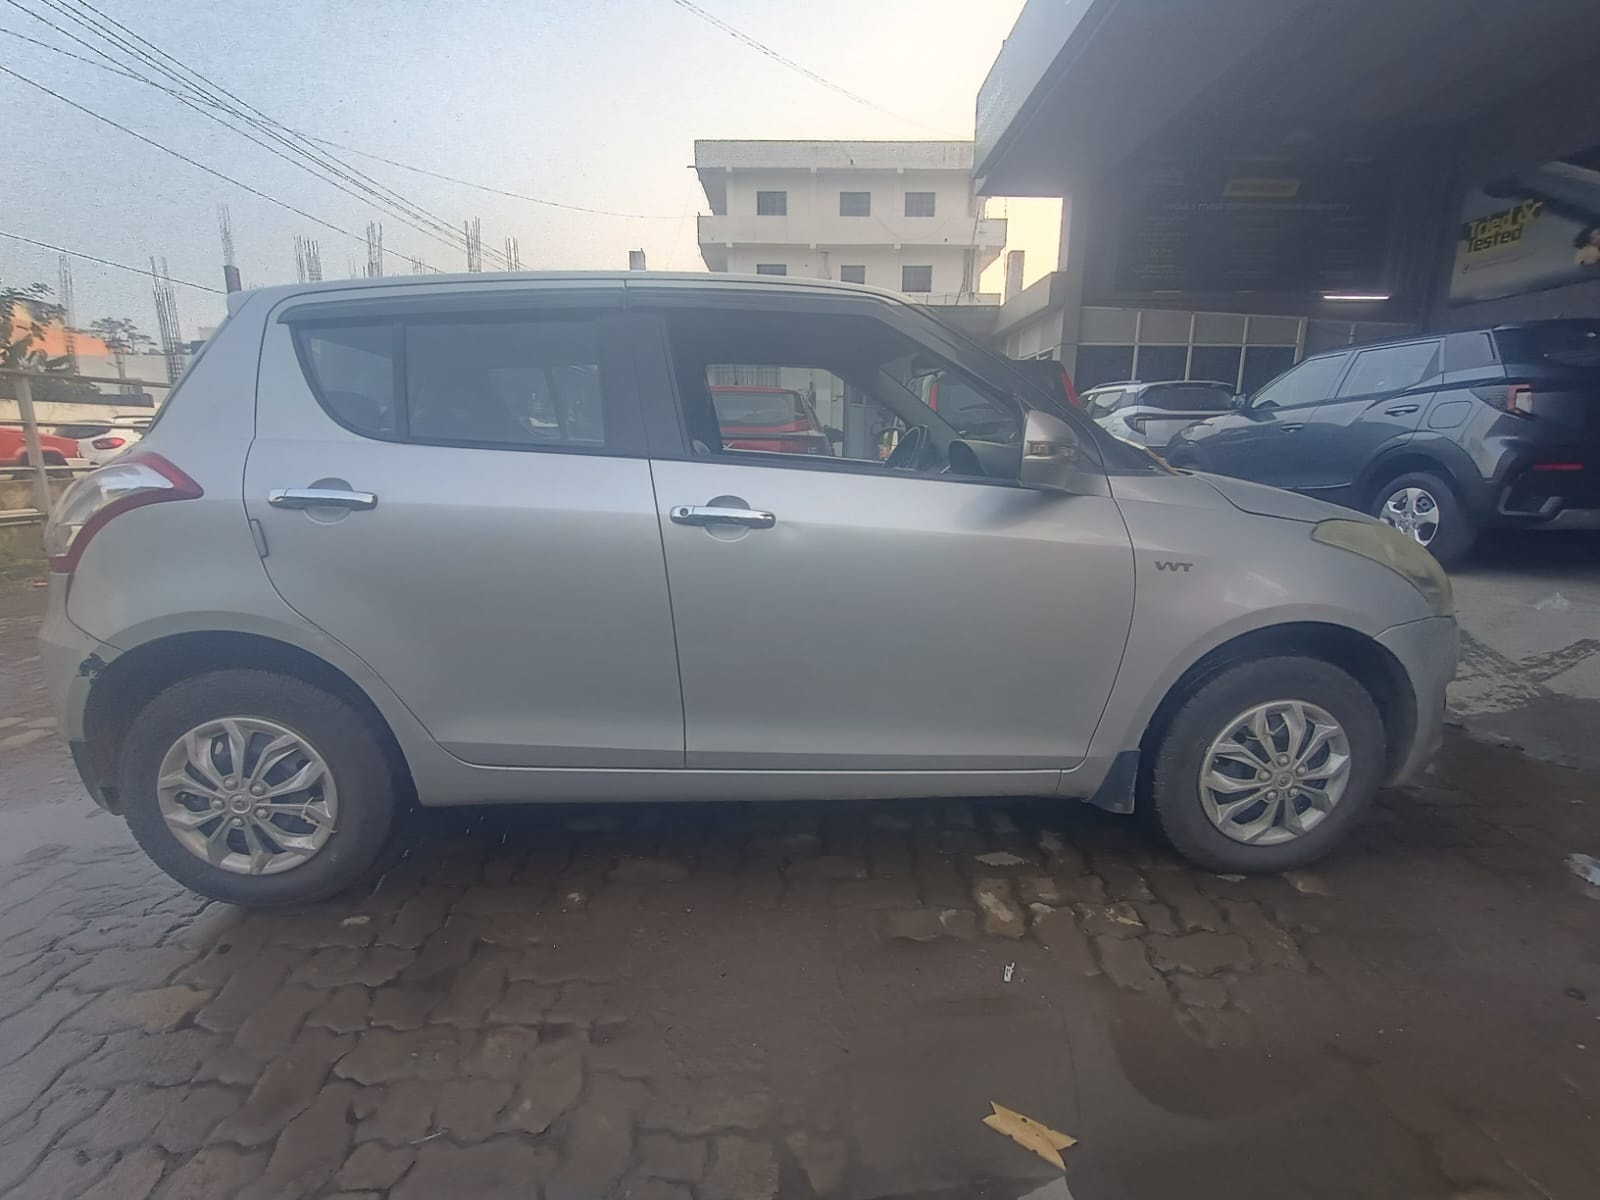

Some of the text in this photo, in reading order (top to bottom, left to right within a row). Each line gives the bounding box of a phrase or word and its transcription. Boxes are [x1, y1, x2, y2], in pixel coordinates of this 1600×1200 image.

[1470, 198, 1544, 237] Tried &
[1468, 224, 1523, 252] Tested
